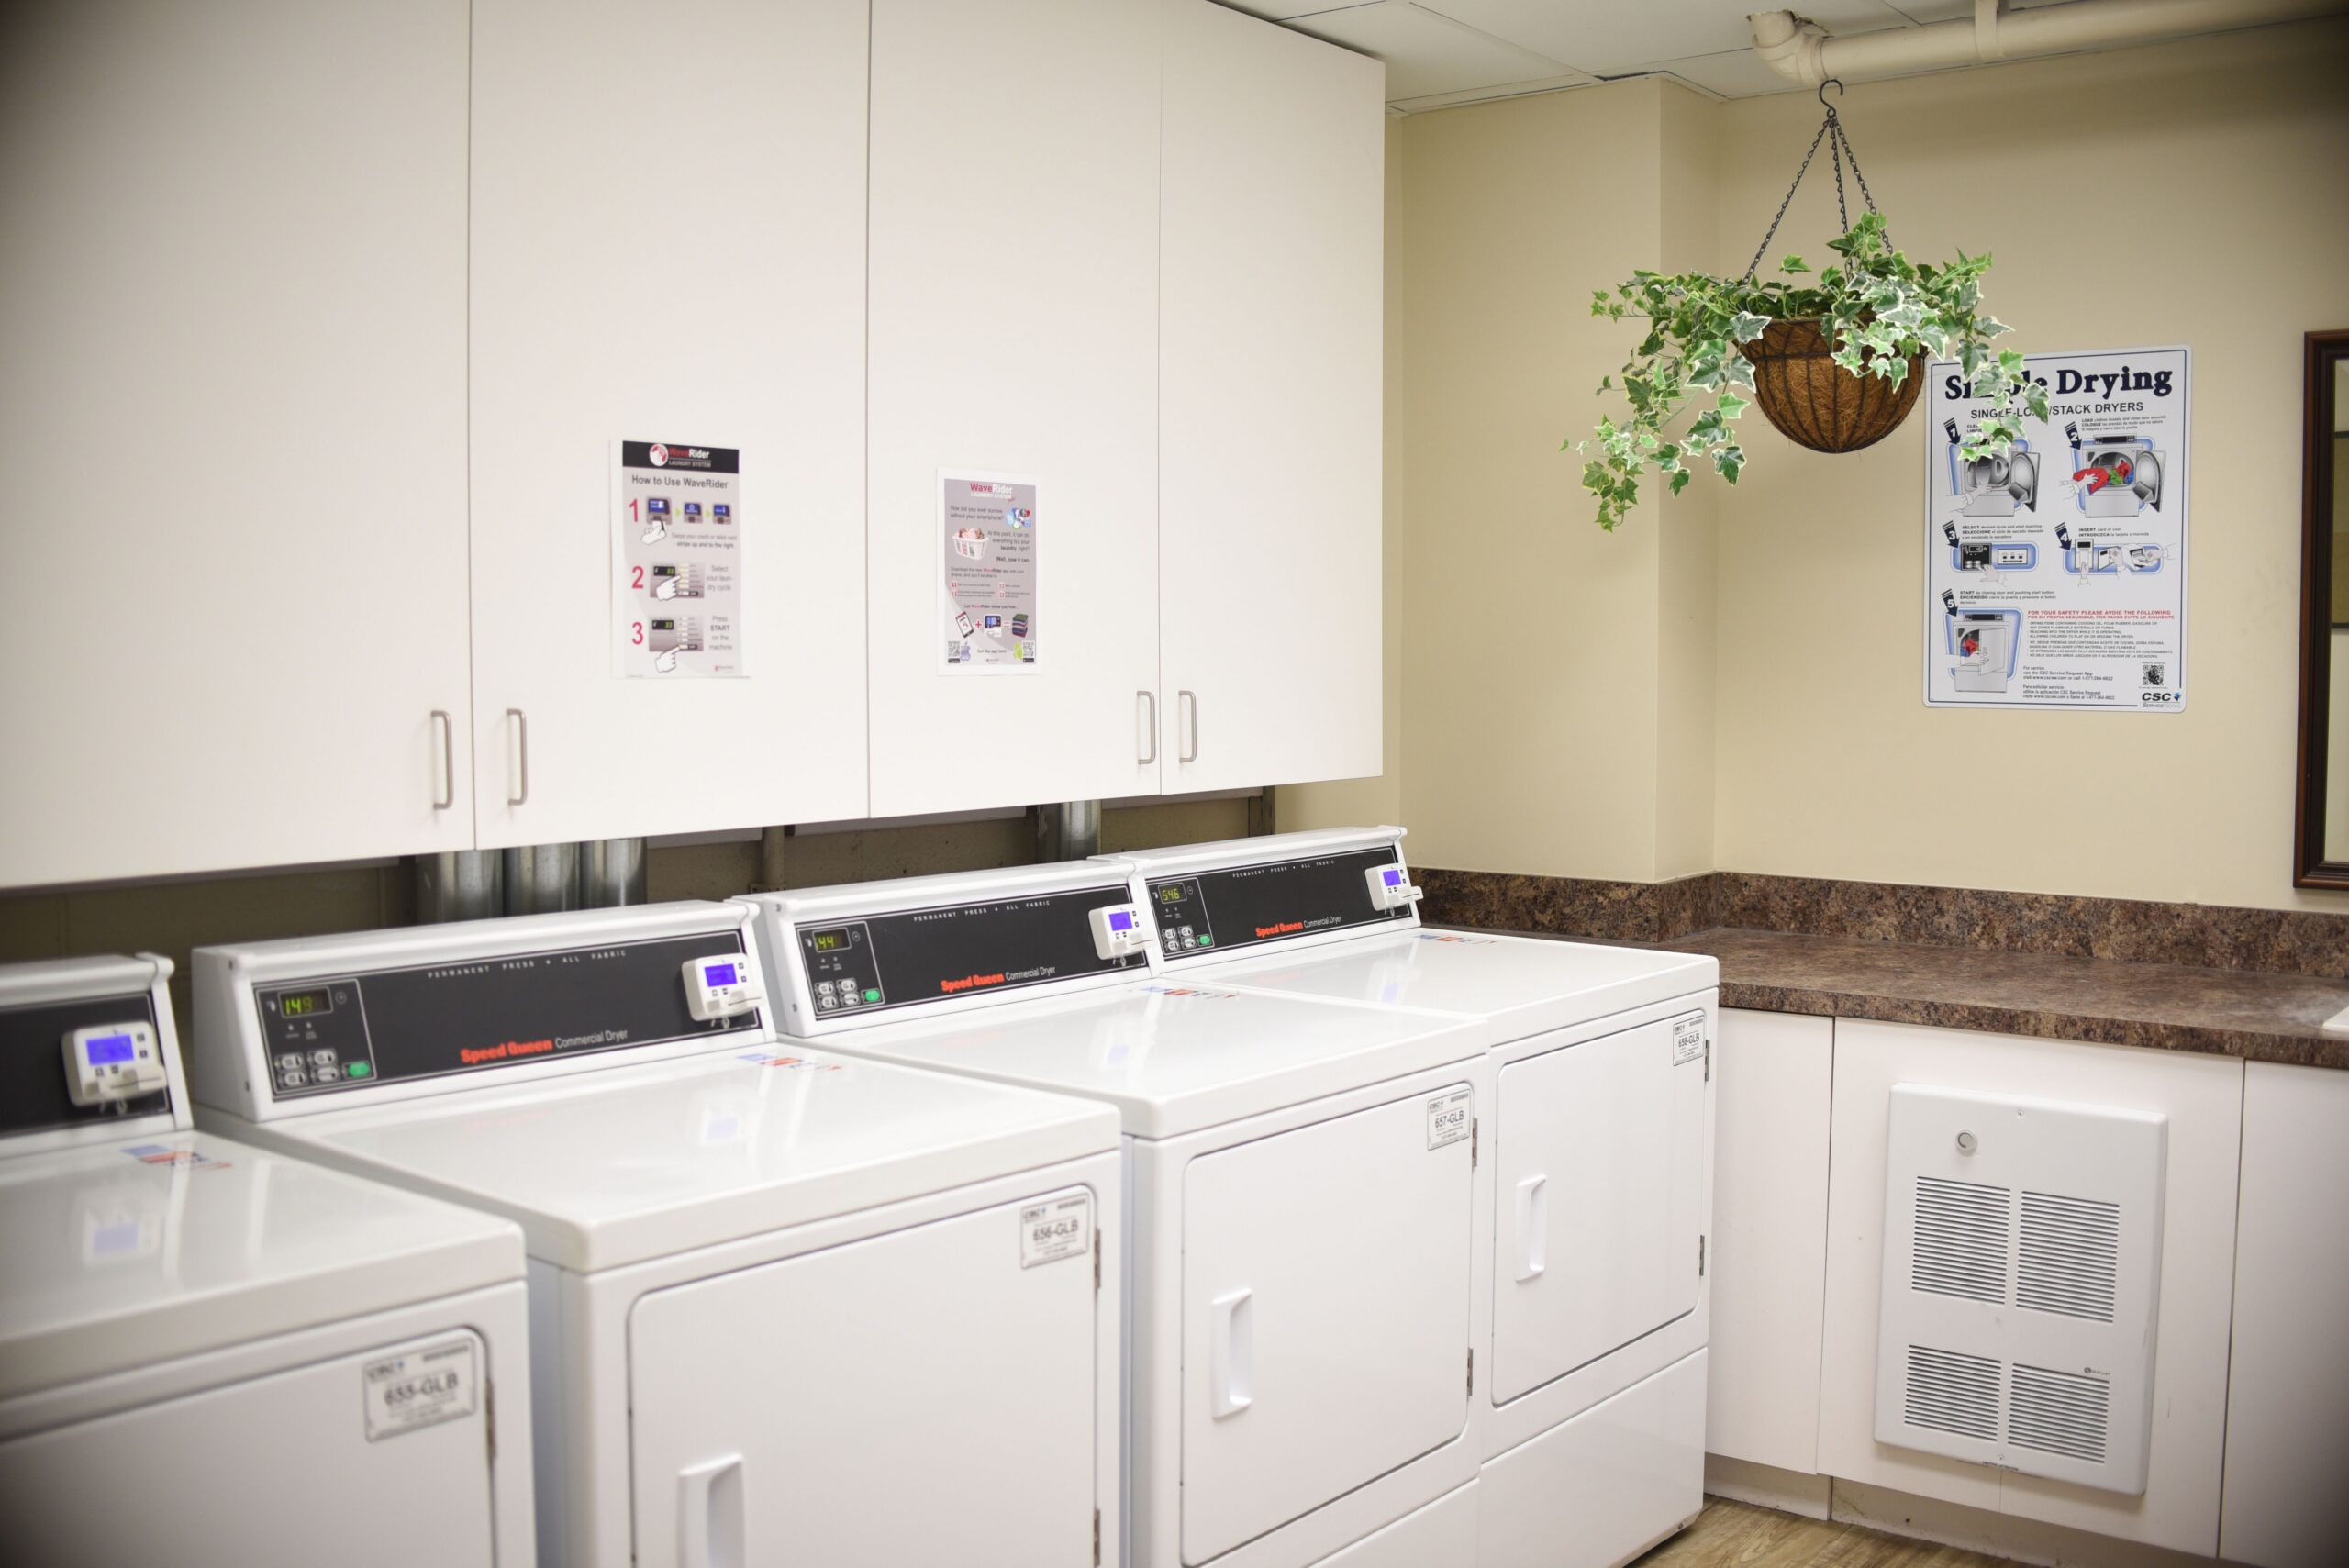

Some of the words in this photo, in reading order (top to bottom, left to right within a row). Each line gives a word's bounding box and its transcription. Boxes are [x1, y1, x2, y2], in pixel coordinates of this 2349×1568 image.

[2056, 366, 2173, 400] Drying
[2095, 402, 2144, 414] DRYERS
[1950, 428, 1956, 438] 1
[2070, 432, 2078, 441] 2
[631, 475, 651, 484] How
[653, 477, 662, 485] to
[664, 477, 681, 486] Use
[683, 478, 729, 489] WaveRider
[970, 483, 1013, 494] WaveRider
[629, 498, 639, 523] 1
[1949, 531, 1955, 540] 3
[2060, 533, 2068, 542] 4
[631, 566, 644, 589] 2
[1947, 599, 1954, 608] 5
[632, 622, 643, 645] 3
[2142, 693, 2172, 702] CSC
[1232, 869, 1264, 879] PERMANENT
[1316, 859, 1335, 867] FABRIC
[1162, 888, 1180, 901] 546
[914, 911, 957, 922] PERMANENT
[964, 907, 988, 917] PRESS
[1026, 900, 1051, 908] FABRIC
[1255, 925, 1280, 939] Speed
[1279, 920, 1304, 933] Queen
[1303, 917, 1330, 929] Commercial
[1329, 915, 1341, 925] Dryer
[428, 965, 491, 979] PERMANENT
[502, 961, 536, 971] PRESS
[562, 955, 581, 964] ALL
[591, 950, 627, 961] FABRIC
[941, 978, 973, 994] Speed
[973, 973, 1005, 986] Queen
[1005, 967, 1040, 982] Commercial
[1040, 965, 1056, 979] Dryer
[460, 1043, 507, 1065] Speed
[507, 1039, 554, 1057] Queen
[554, 1032, 605, 1050] Commercial
[605, 1029, 629, 1043] Dryer
[1435, 1110, 1464, 1129] 657-GLB
